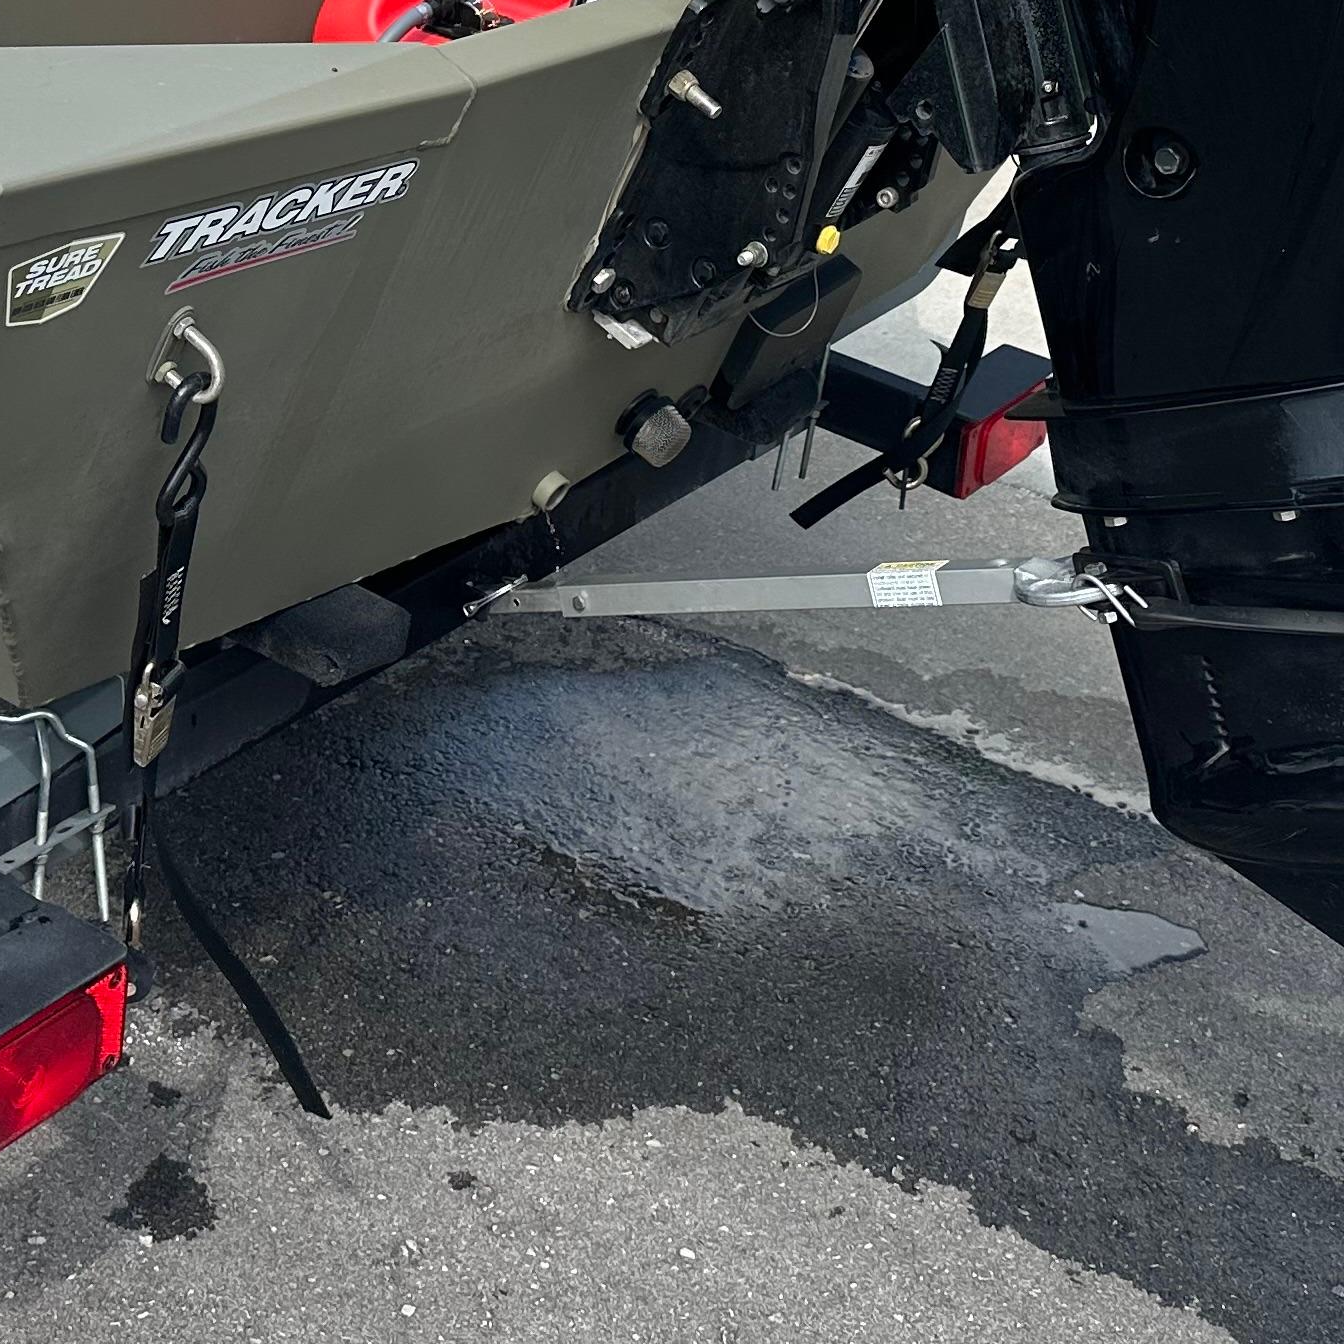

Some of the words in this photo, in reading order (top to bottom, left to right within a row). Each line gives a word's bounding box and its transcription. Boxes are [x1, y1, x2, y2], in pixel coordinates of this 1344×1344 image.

[148, 161, 416, 262] TRACKER
[14, 259, 103, 298] TREAD
[26, 243, 104, 279] SURE
